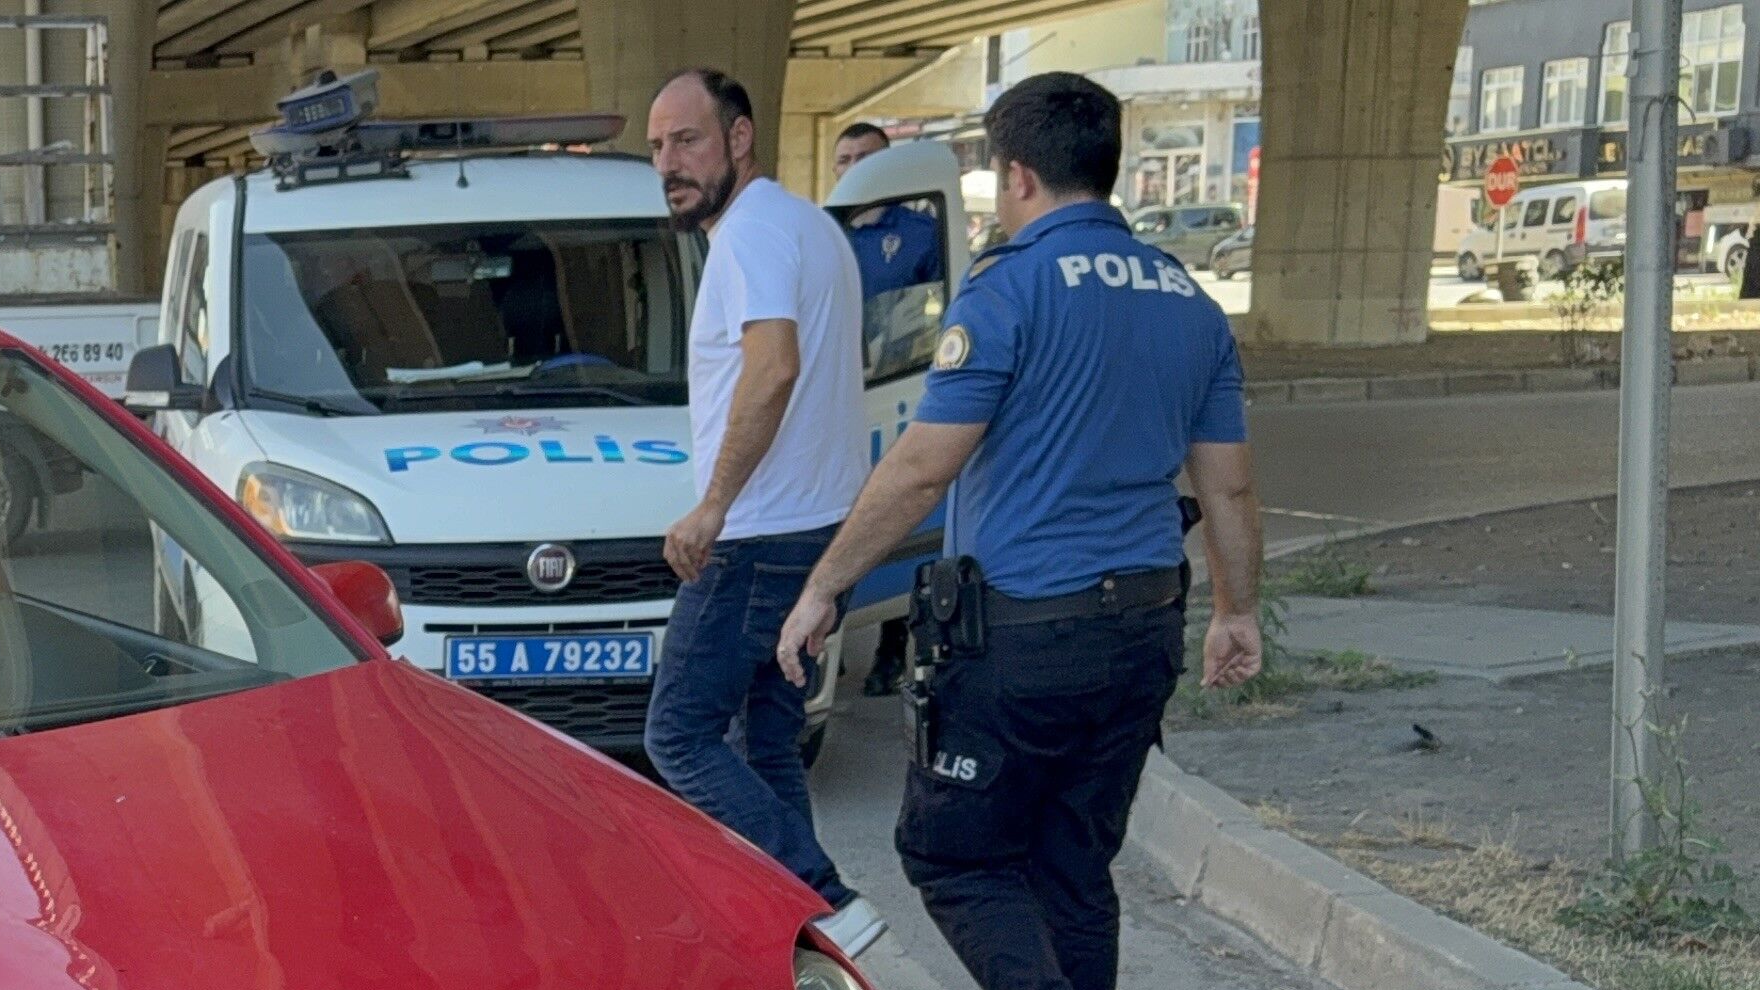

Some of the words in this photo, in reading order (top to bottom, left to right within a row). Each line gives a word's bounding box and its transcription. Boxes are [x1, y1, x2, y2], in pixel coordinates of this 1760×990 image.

[1487, 171, 1518, 190] DUR
[84, 343, 101, 362] 89
[105, 343, 124, 361] 40
[539, 556, 565, 578] FIAT
[457, 641, 497, 673] 55
[510, 641, 529, 672] A
[543, 639, 641, 672] 79232
